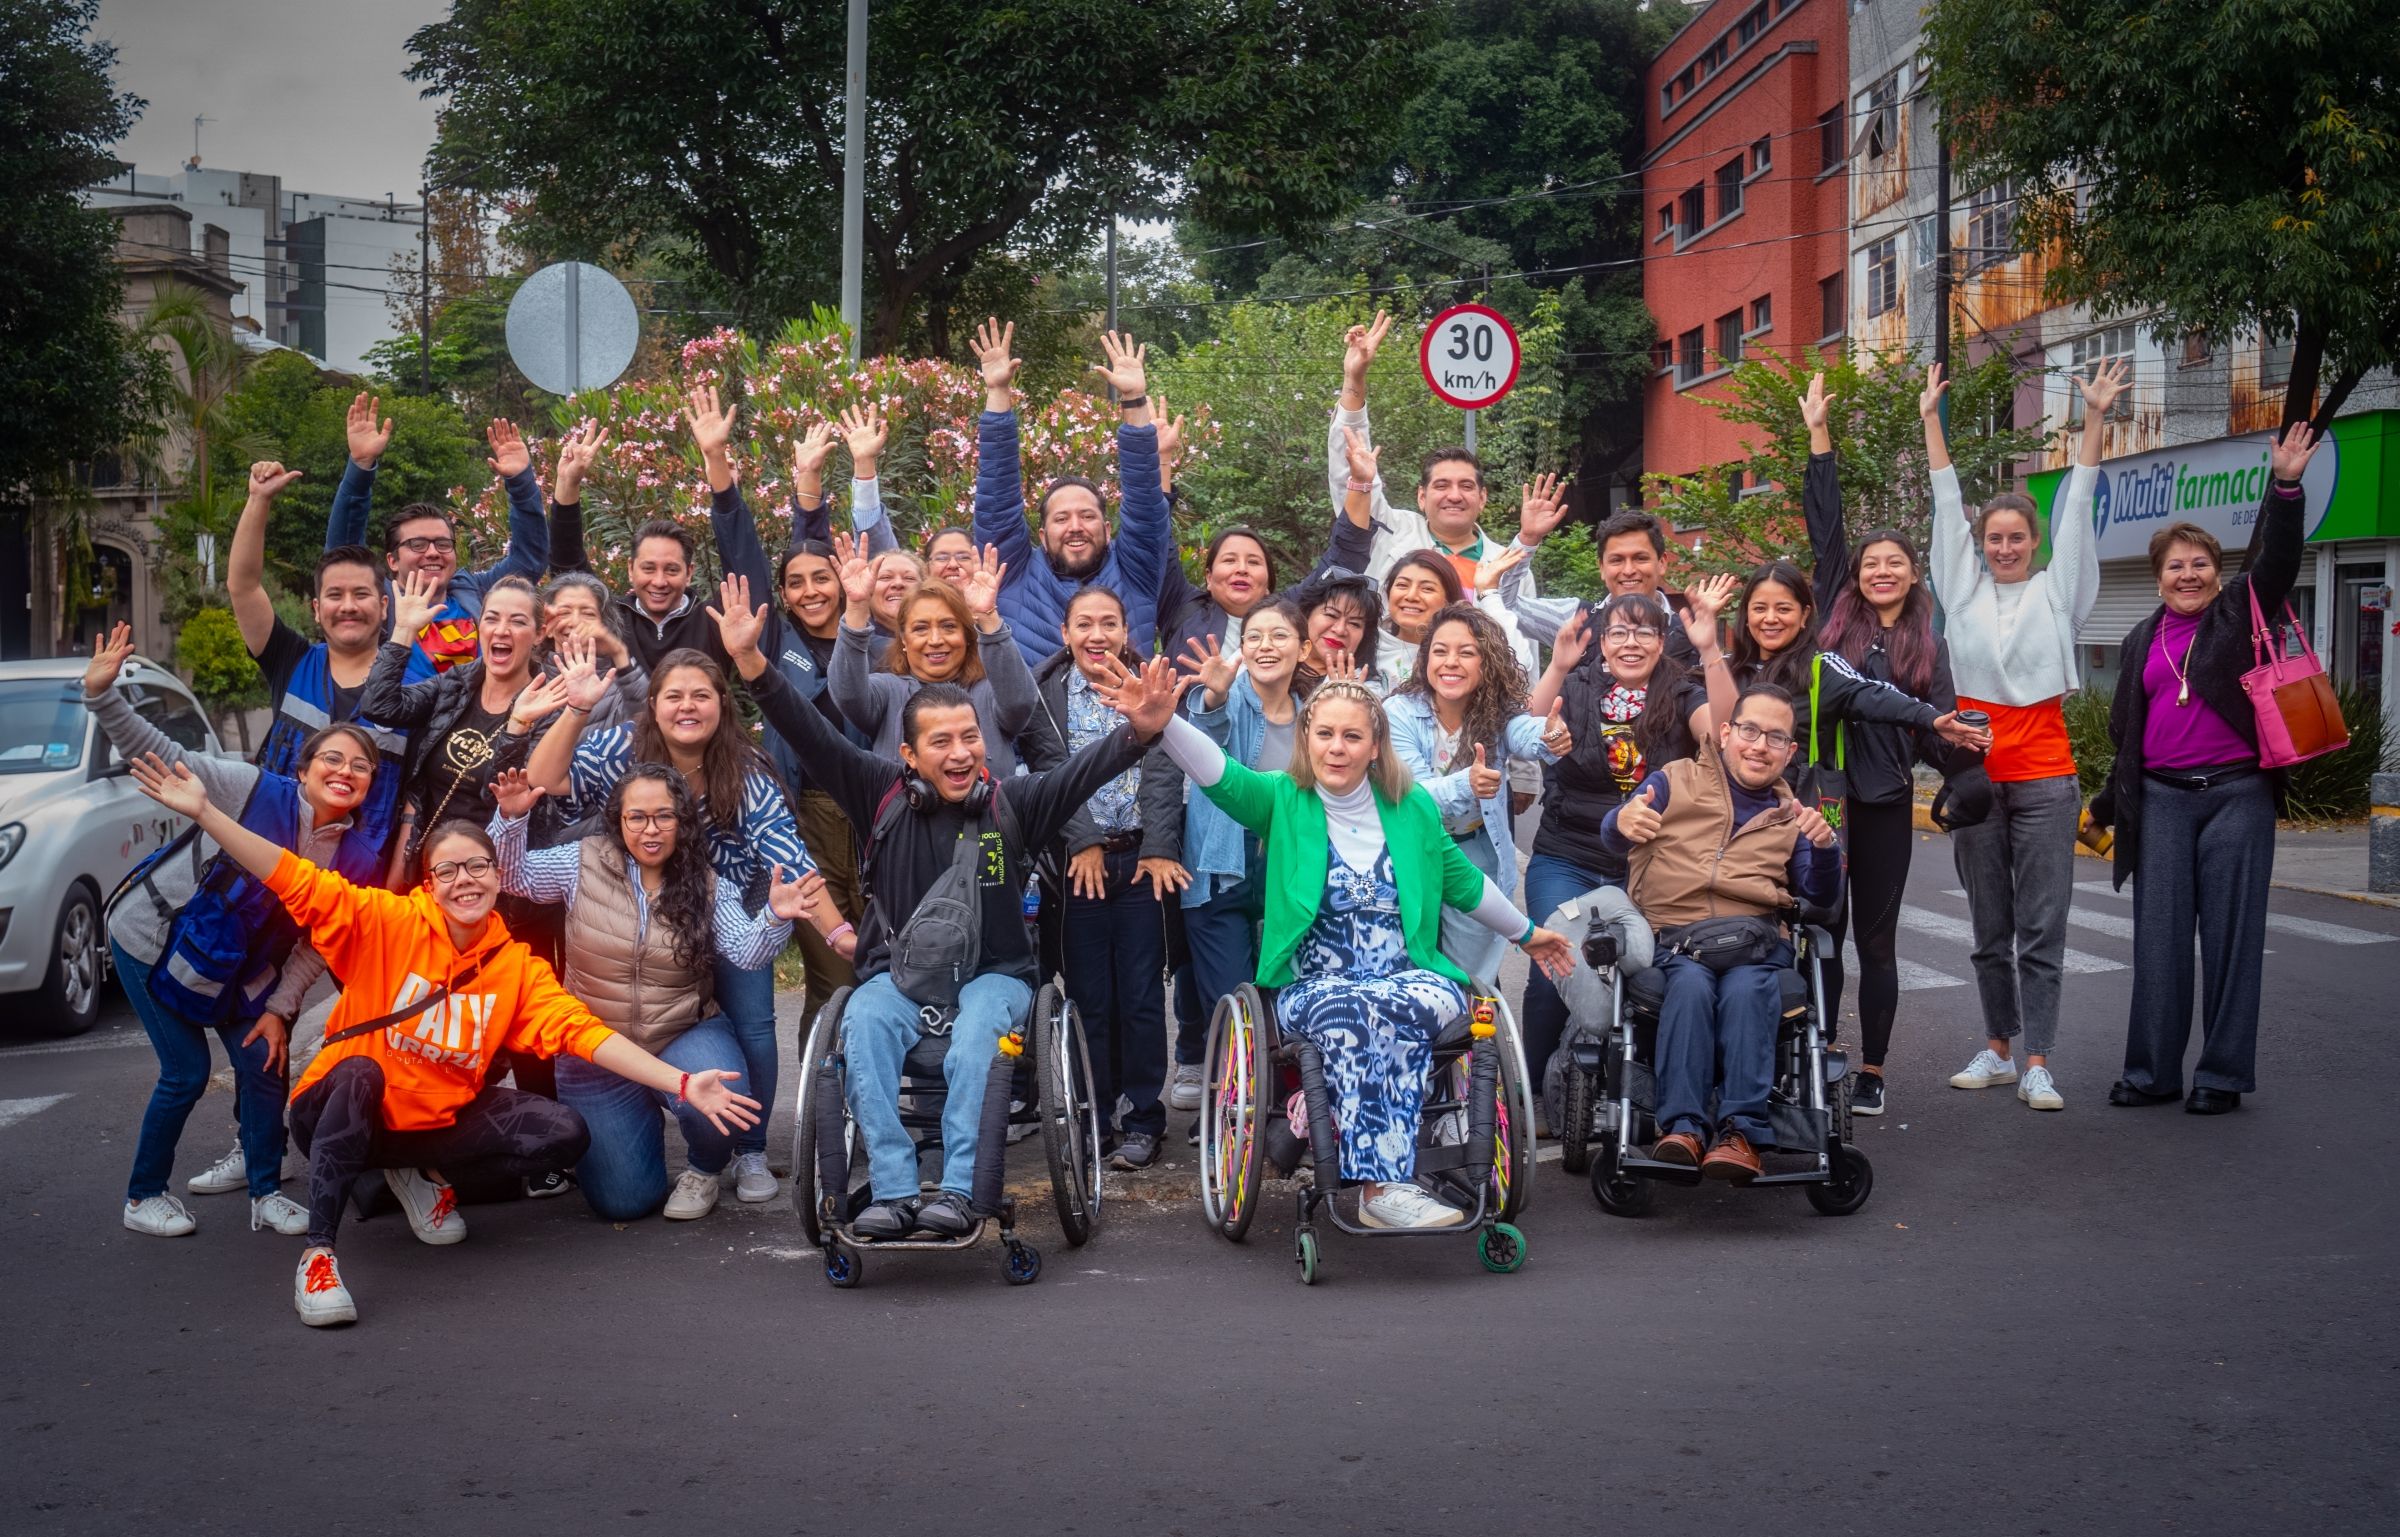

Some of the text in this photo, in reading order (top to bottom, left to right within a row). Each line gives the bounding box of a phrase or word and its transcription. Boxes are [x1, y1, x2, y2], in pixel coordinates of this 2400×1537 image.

[1447, 323, 1493, 362] 30
[1444, 369, 1496, 390] km/h
[2113, 461, 2175, 523] Multi
[2175, 452, 2268, 511] farmaci
[2231, 509, 2258, 526] DE DES
[390, 971, 497, 1051] PATY
